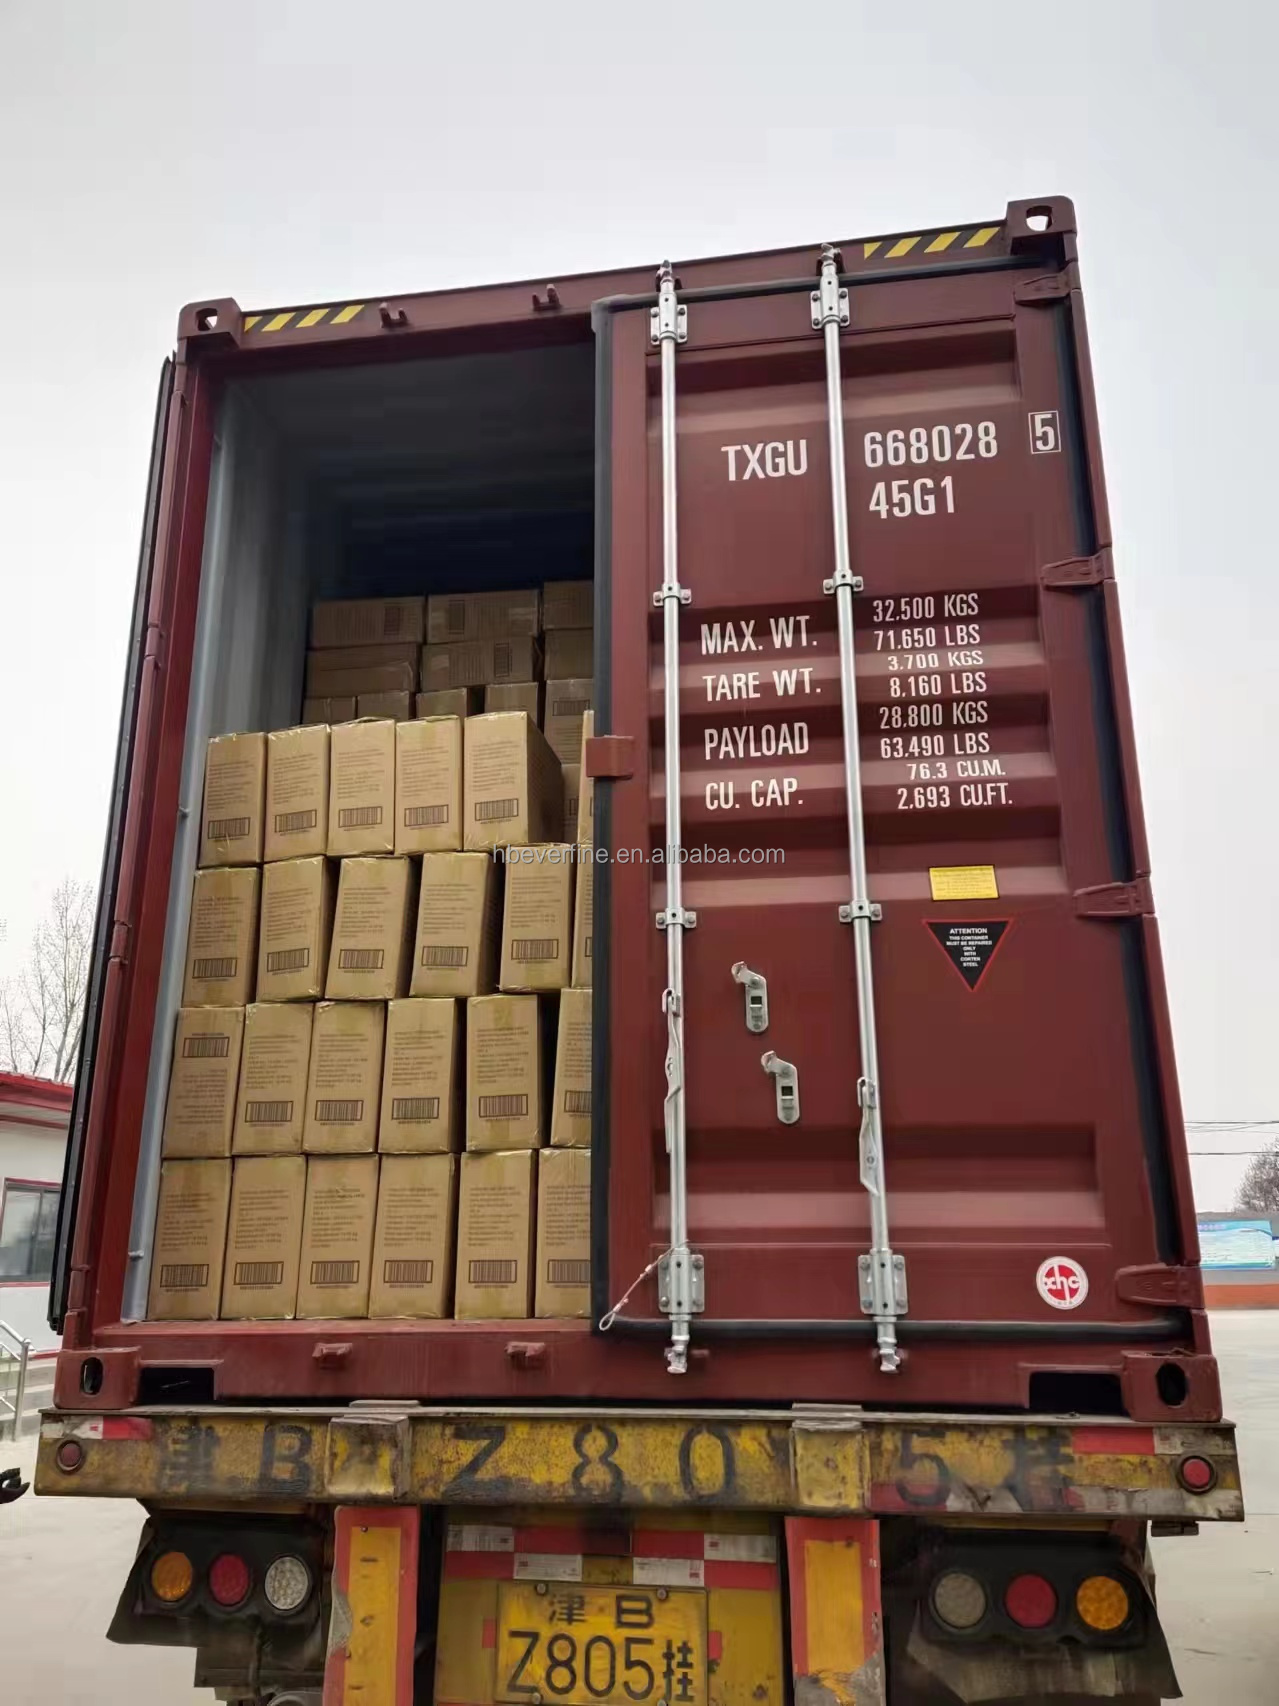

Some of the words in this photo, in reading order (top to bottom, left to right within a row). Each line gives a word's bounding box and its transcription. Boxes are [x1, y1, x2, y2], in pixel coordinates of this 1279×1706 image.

[721, 439, 808, 481] TXGU
[864, 421, 998, 468] 668028
[1034, 414, 1055, 451] 5
[869, 476, 955, 519] 45G1
[944, 593, 979, 617] KGS
[701, 620, 763, 655] MAX.
[770, 615, 817, 648] WT.
[944, 624, 981, 646] LBS
[947, 650, 984, 667] KGS
[702, 672, 760, 701] TARE
[772, 668, 821, 696] WT.
[951, 672, 987, 694] LBS
[952, 701, 988, 724] KGS
[704, 722, 809, 760] PAYLOAD
[953, 732, 990, 755] LBS
[906, 762, 948, 780] 76.3
[705, 782, 740, 810] CU.
[751, 778, 803, 807] CAP.
